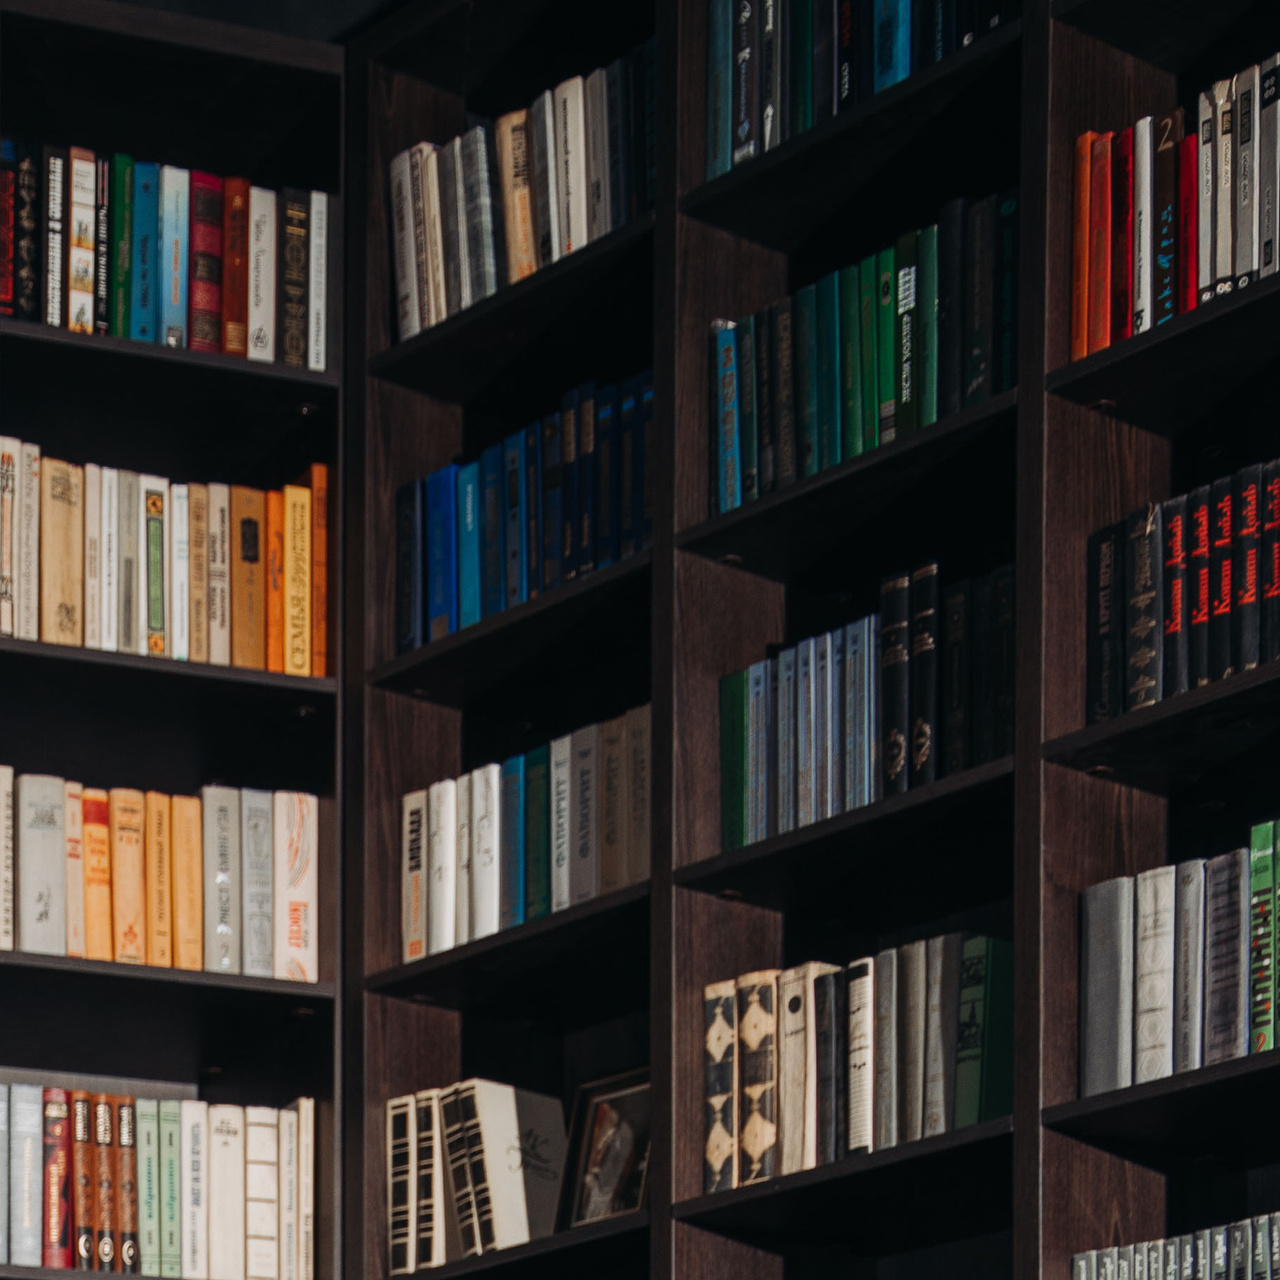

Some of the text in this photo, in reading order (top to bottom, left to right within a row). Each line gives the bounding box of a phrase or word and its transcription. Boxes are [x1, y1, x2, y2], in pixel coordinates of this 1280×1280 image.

[1165, 514, 1186, 634] Конан Дойль
[1191, 504, 1210, 625] Конан Дойль
[1213, 494, 1232, 616] Конан Дойль
[1237, 483, 1260, 605] Конан Дойль
